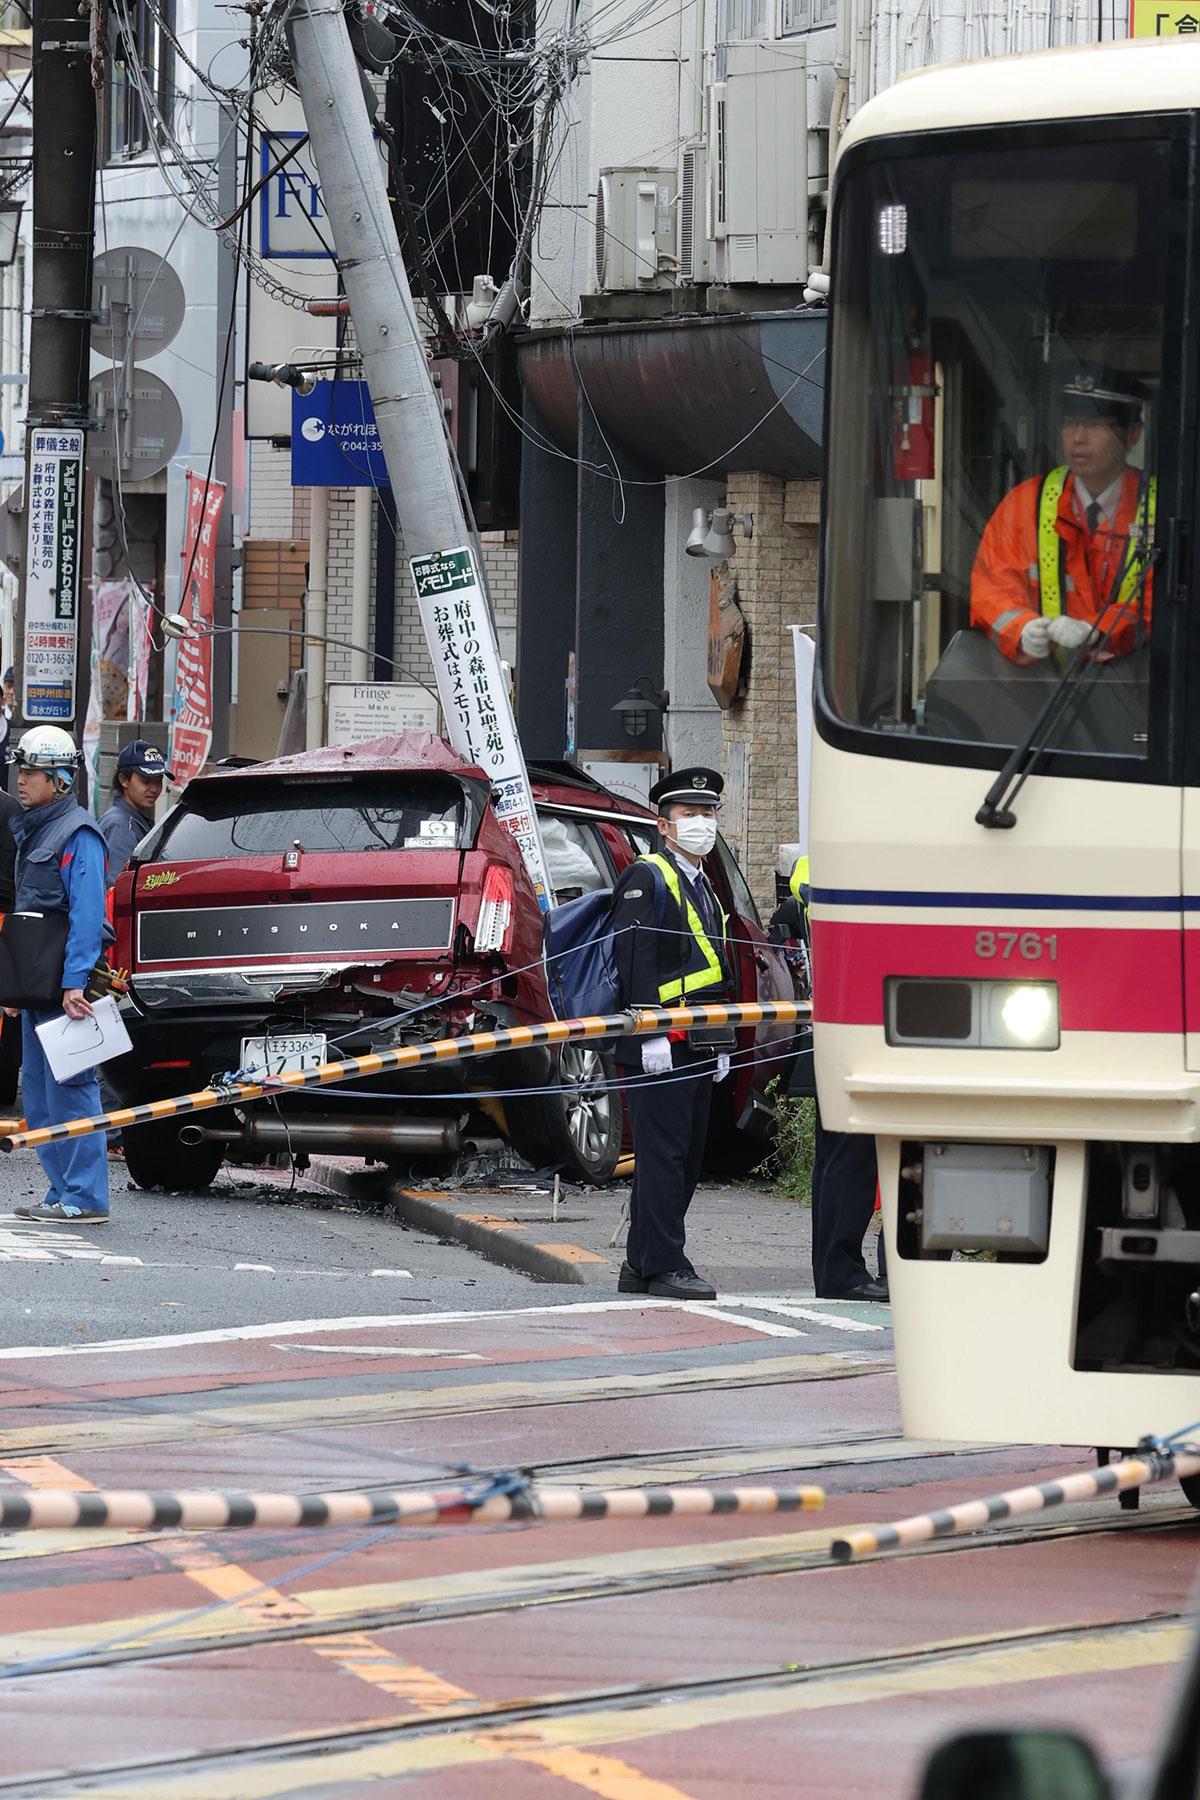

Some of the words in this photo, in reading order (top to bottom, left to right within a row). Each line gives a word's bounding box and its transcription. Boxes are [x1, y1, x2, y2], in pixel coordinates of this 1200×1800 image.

[327, 423, 378, 437] ながれほ
[36, 437, 79, 452] 葬儀全般
[30, 463, 43, 580] お葬式はメモリードへ
[42, 462, 56, 569] 府中の森市民聖苑の
[414, 560, 456, 577] お葬式なら
[419, 566, 473, 594] メモリード
[28, 635, 74, 649] 24時間受付
[26, 652, 74, 665] 0120-1-365-24
[454, 600, 505, 766] 府中の森市民聖苑の
[27, 687, 71, 699] 旧甲州街道
[354, 687, 391, 702] Fringe
[30, 704, 69, 716] 清水が丘1-1
[368, 703, 396, 711] Menu
[187, 922, 399, 939] MITSUOKA
[975, 931, 1057, 960] 8761
